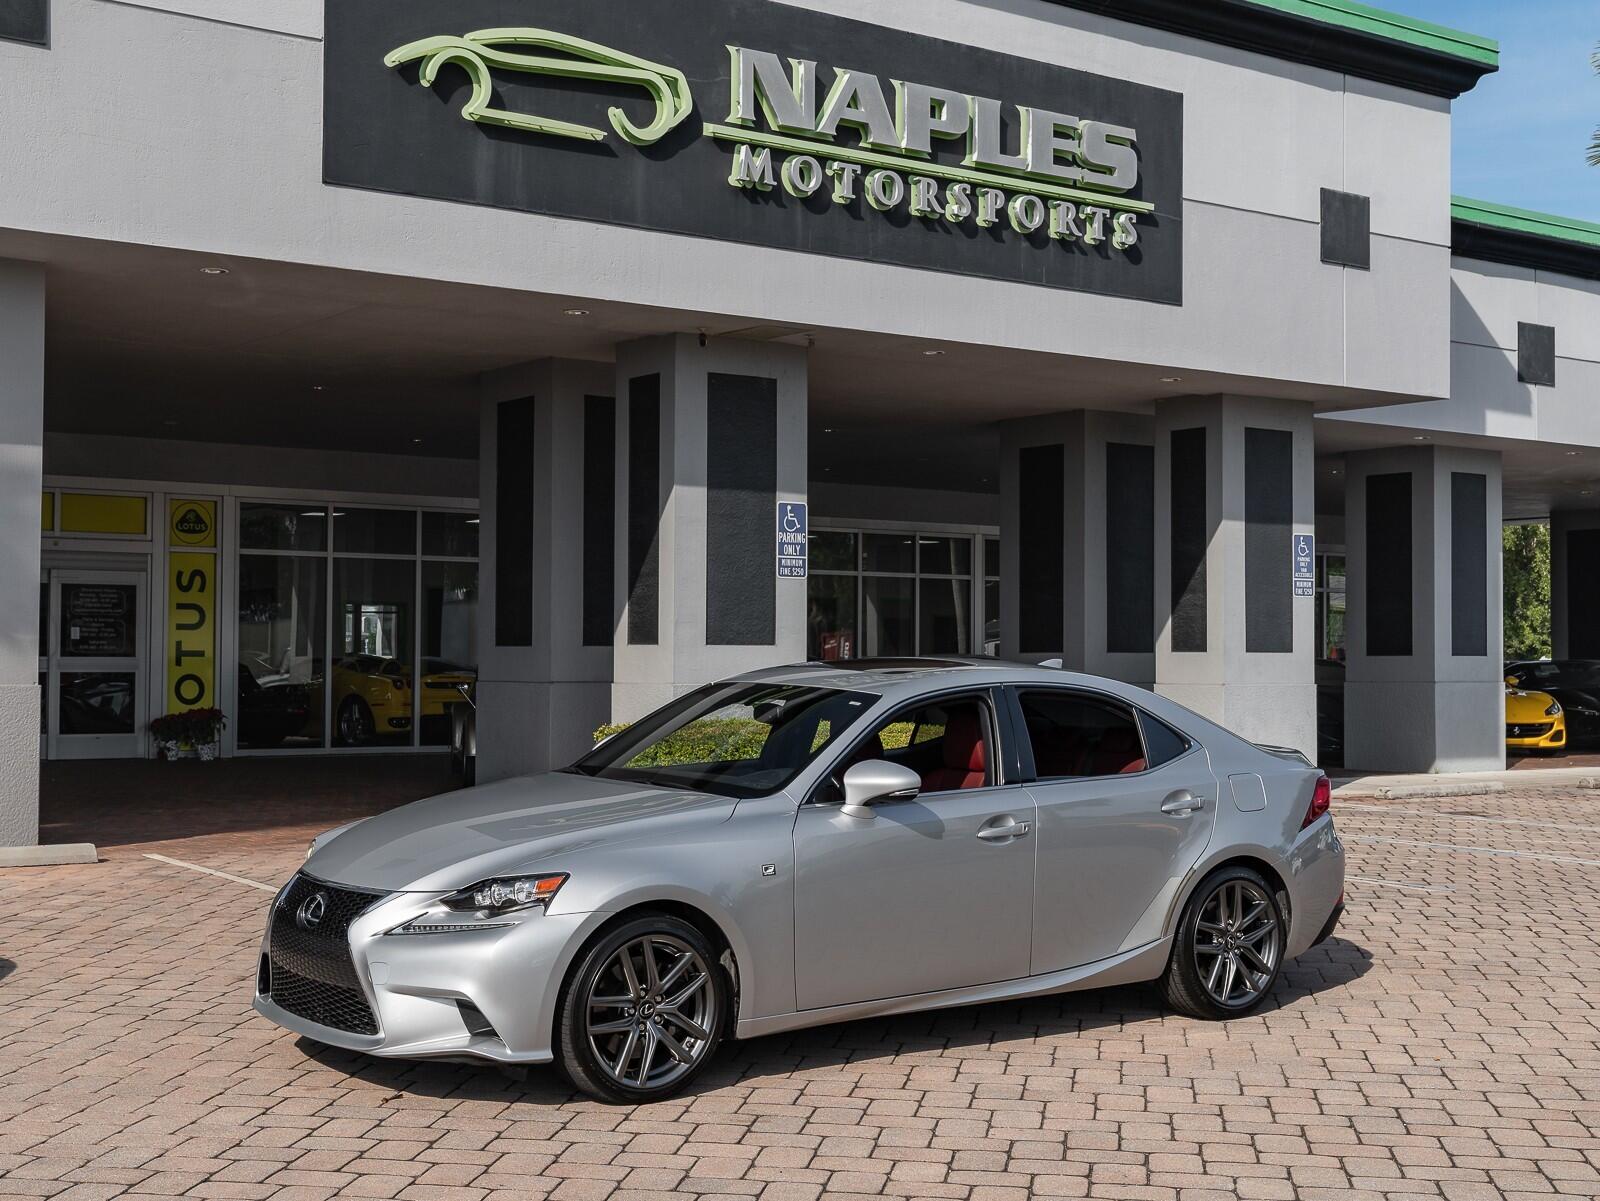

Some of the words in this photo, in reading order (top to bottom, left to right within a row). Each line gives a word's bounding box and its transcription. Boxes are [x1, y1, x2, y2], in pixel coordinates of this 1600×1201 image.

[725, 44, 1138, 194] NAPLES
[728, 142, 1138, 250] MOTORSPORTS
[177, 522, 206, 531] LOTUS
[778, 531, 806, 543] PARKING
[783, 544, 801, 555] ONLY
[781, 558, 803, 567] MINIMUM
[779, 567, 791, 576] FINE
[792, 567, 804, 576] $250
[174, 568, 206, 706] OTUS
